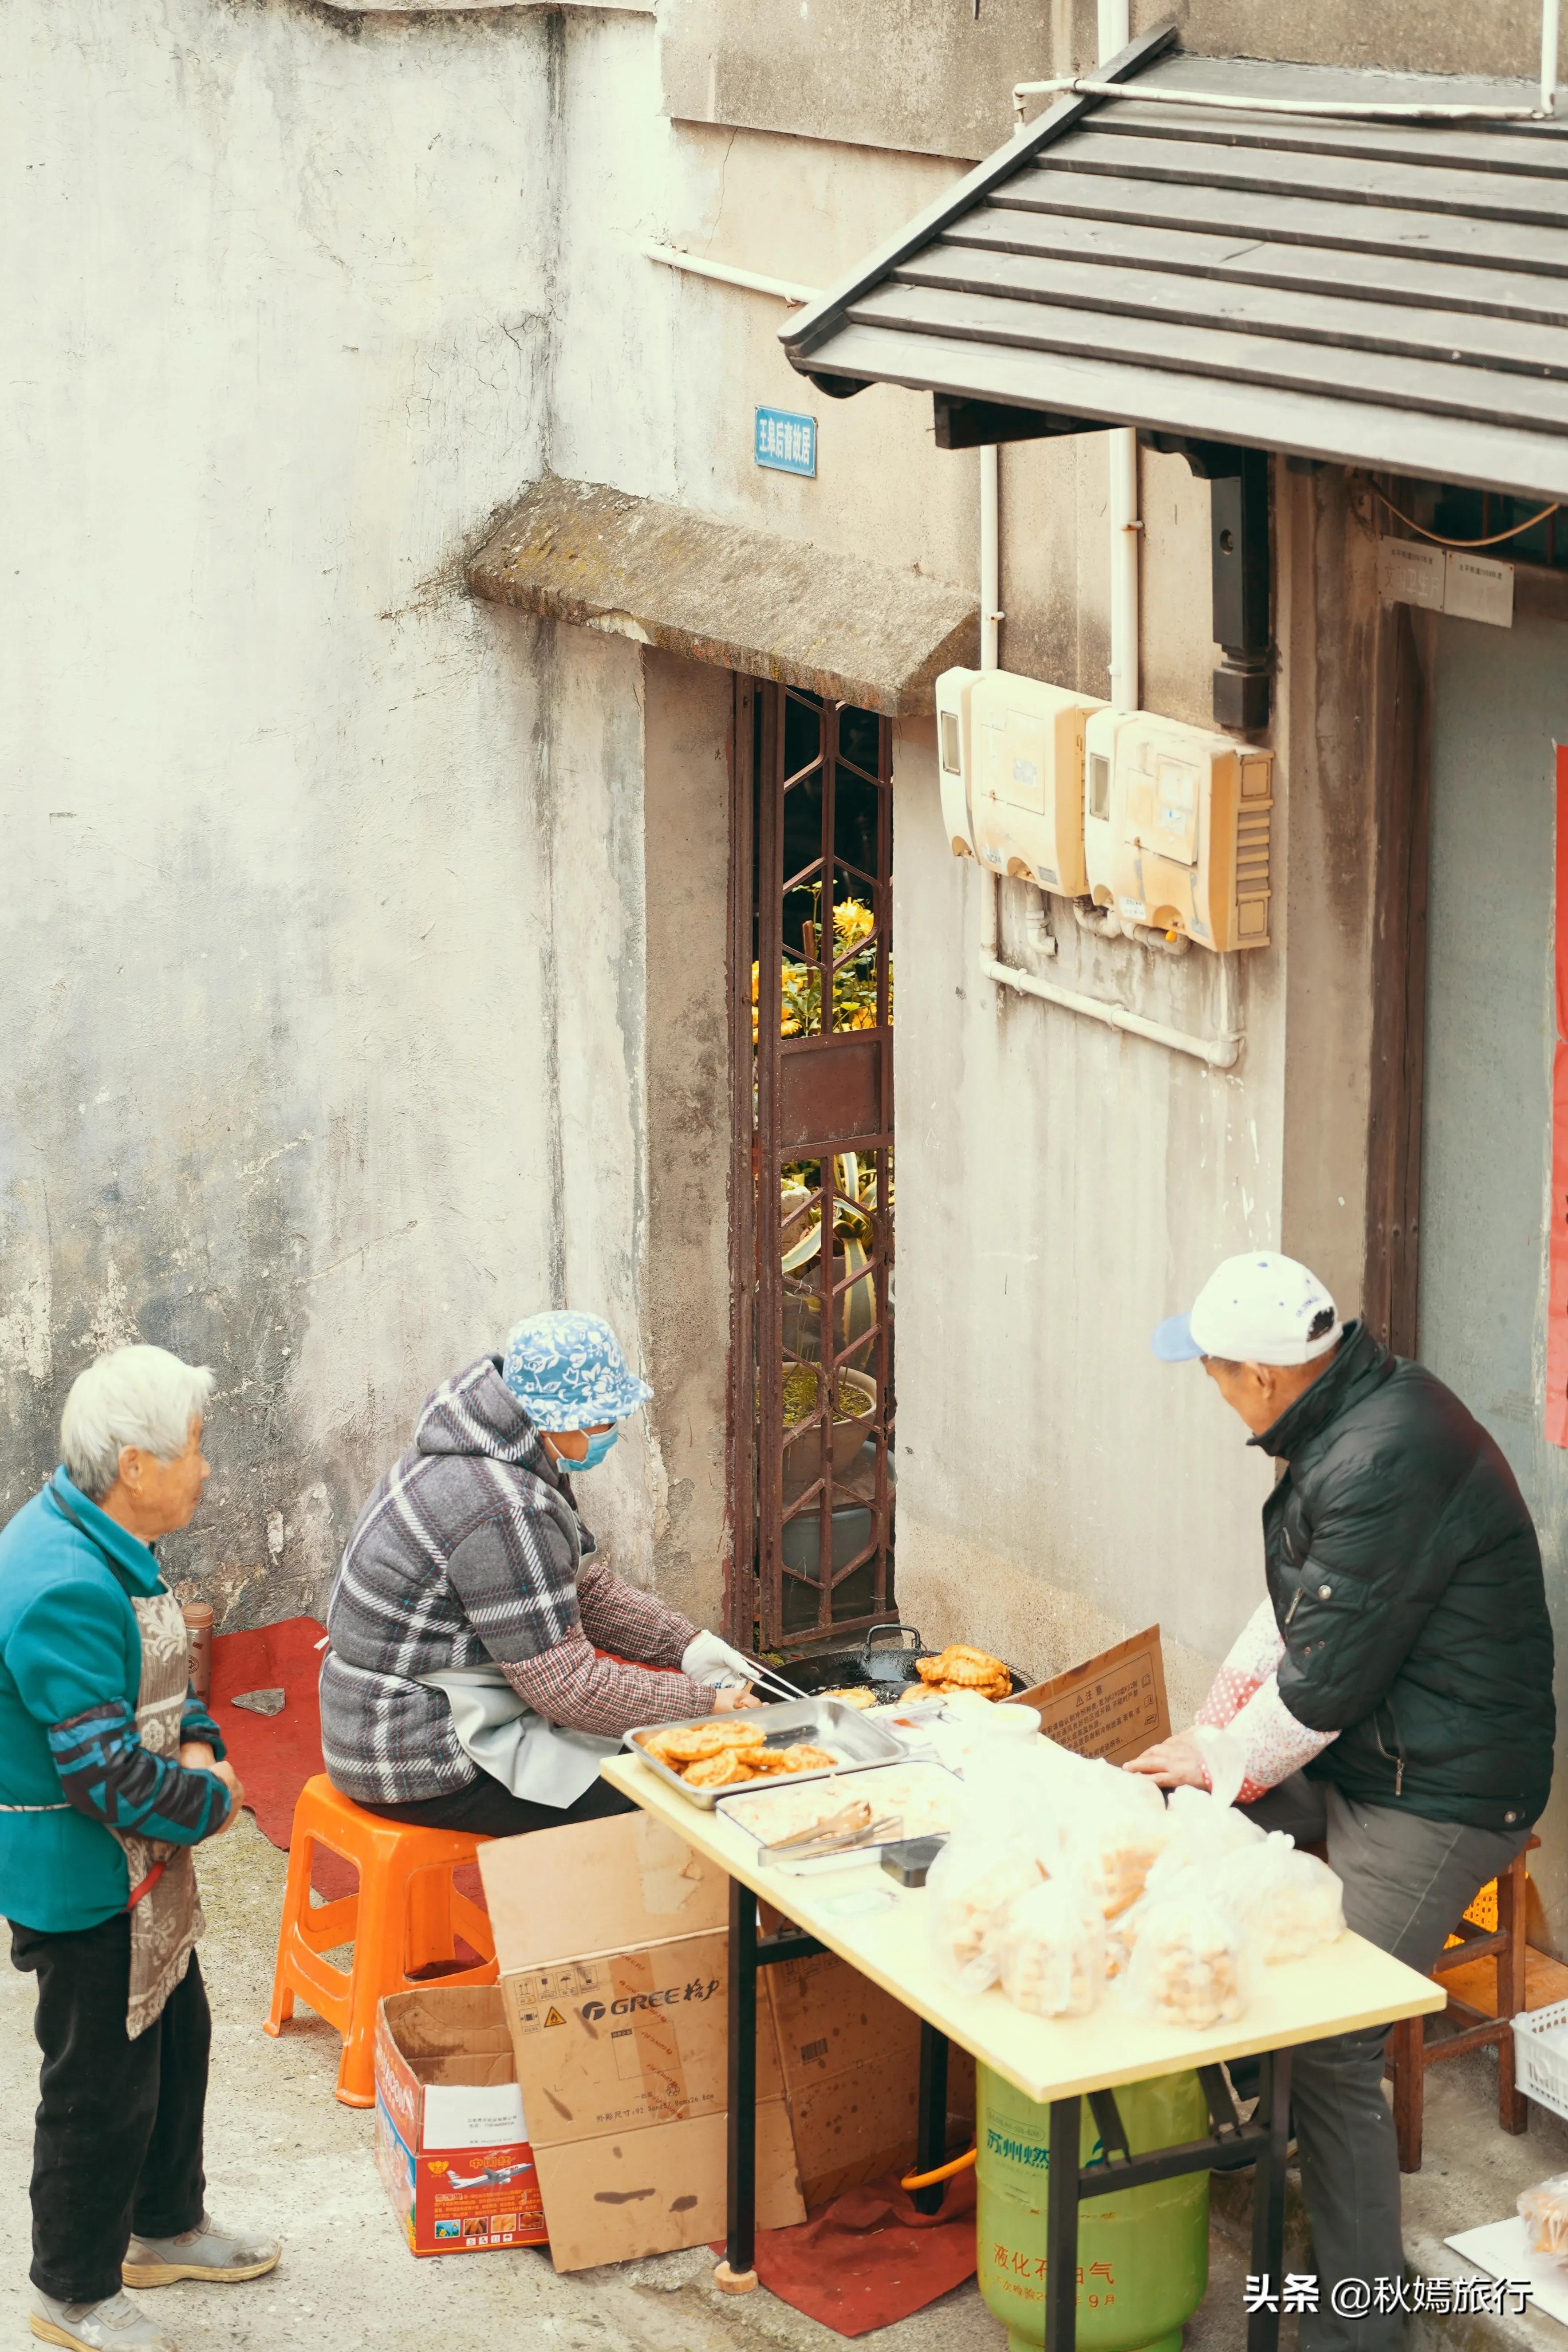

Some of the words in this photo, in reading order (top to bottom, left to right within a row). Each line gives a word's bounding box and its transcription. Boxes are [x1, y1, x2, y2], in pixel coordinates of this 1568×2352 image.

[611, 1987, 681, 2015] GREE
[683, 1978, 720, 2002] 格力
[469, 2156, 512, 2169] 中国红
[987, 2128, 1050, 2170] 苏州燃
